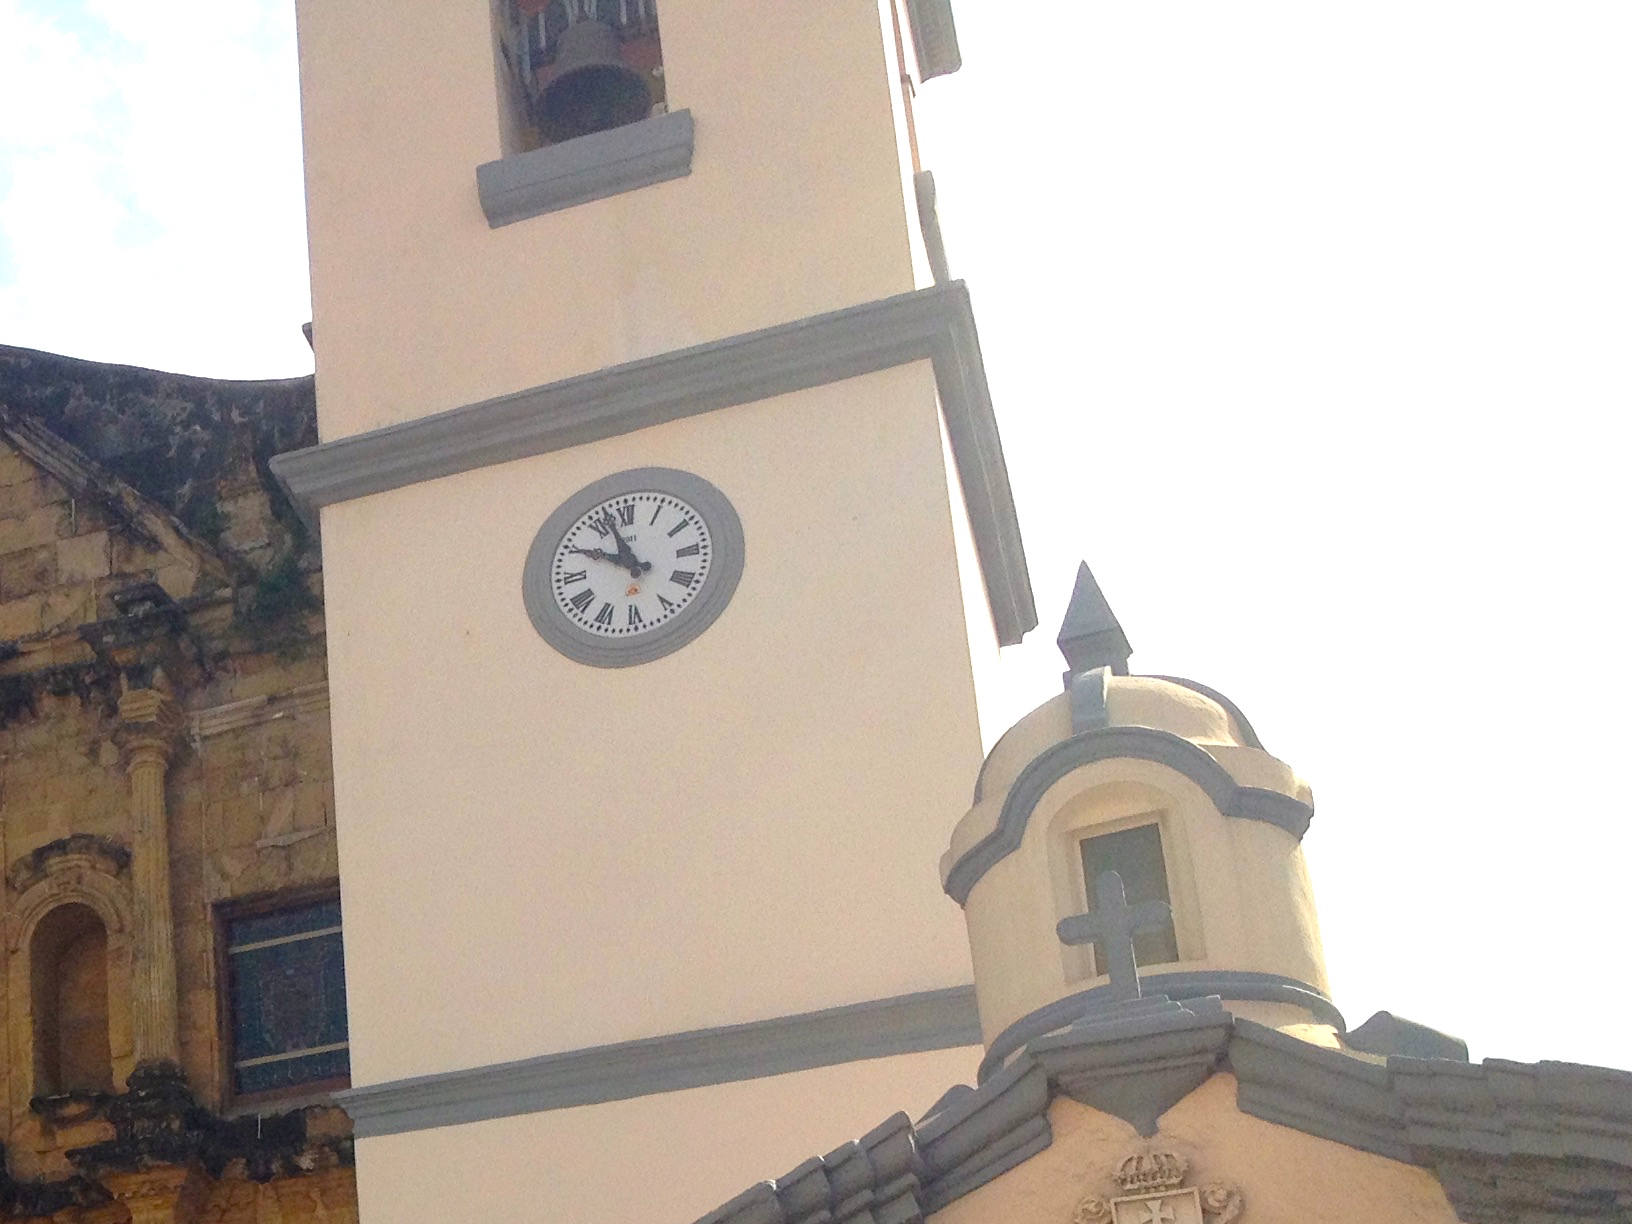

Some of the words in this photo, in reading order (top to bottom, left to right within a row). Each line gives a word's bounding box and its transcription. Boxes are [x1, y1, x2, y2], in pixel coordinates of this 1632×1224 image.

[649, 504, 662, 526] I
[667, 518, 689, 538] II
[676, 542, 699, 559] III
[563, 569, 586, 585] IX
[569, 588, 596, 614] VIII
[657, 593, 674, 611] V
[594, 602, 614, 625] VII
[628, 604, 643, 625] VI
